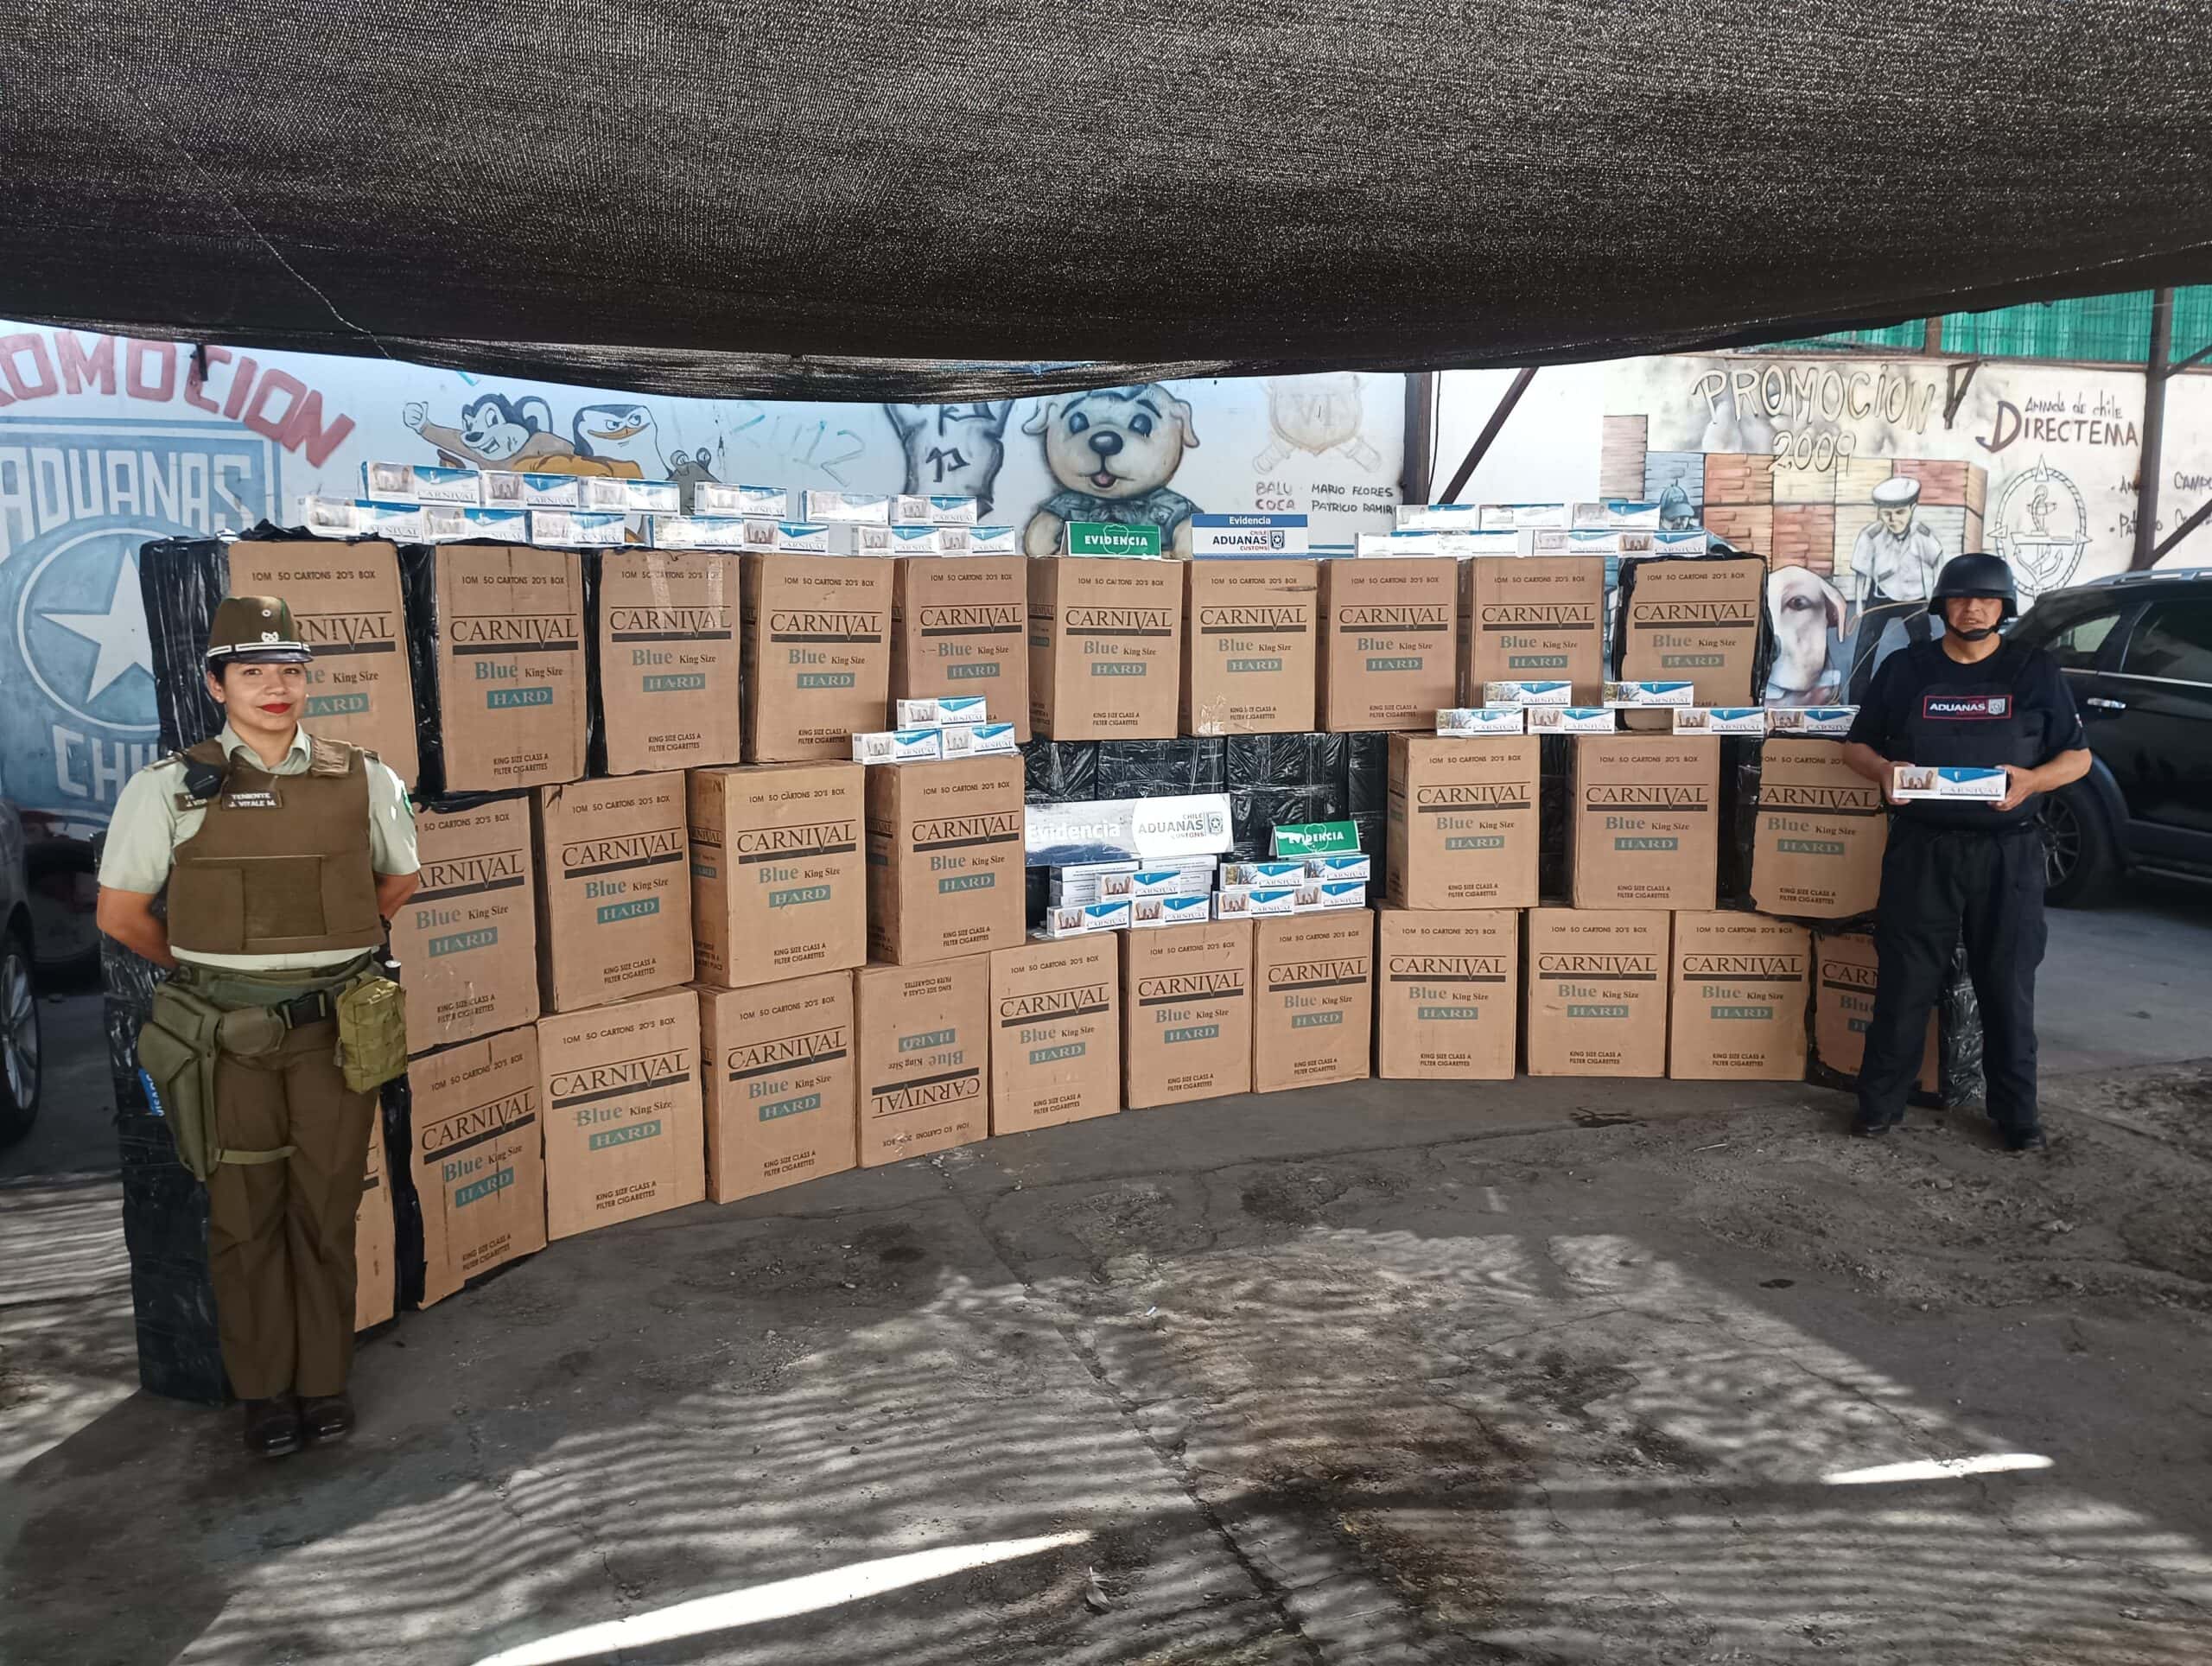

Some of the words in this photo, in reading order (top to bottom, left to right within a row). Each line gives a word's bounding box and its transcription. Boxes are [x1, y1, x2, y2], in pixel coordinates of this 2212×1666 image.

[0, 331, 355, 468] OMOCION
[1975, 401, 2138, 453] DIRECTEMA
[1312, 484, 1345, 495] MARIO
[1353, 486, 1394, 497] FLORES
[0, 447, 254, 557] ADUANAS
[1312, 500, 1357, 512] PATRICIO
[1229, 516, 1271, 525] Evidencia
[1085, 536, 1148, 546] EVIDENCIA
[611, 610, 732, 637] CARNIVAL
[920, 607, 1022, 630] CARNIVAL
[1066, 610, 1172, 634] CARNIVAL
[1200, 608, 1306, 630] CARNIVAL
[1340, 607, 1448, 629] CARNIVAL
[1482, 607, 1595, 627] CARNIVAL
[1634, 604, 1755, 626] CARNIVAL
[296, 617, 394, 650] RNIVAL
[450, 619, 578, 648] CARNIVAL
[771, 614, 882, 640] CARNIVAL
[1653, 634, 1692, 647] Blue
[789, 649, 826, 664] Blue
[334, 673, 357, 683] King
[359, 671, 378, 681] Size
[474, 662, 518, 679] Blue
[525, 668, 544, 677] King
[547, 666, 563, 676] Size
[803, 676, 850, 685] HARD
[494, 690, 548, 705] HARD
[1929, 703, 1986, 711] ADUANAS
[494, 766, 512, 774] FILTER
[513, 763, 548, 773] CIGARETTES
[1417, 785, 1530, 808] CARNIVAL
[1586, 787, 1708, 809] CARNIVAL
[1760, 788, 1876, 813] ARNIVAL
[912, 816, 1019, 842] CARNIVAL
[1139, 821, 1204, 834] ADUANAS
[1437, 817, 1473, 830] Blue
[1768, 817, 1809, 832] Blue
[1815, 826, 1836, 835] King
[563, 832, 683, 866] CARNIVAL
[737, 824, 856, 852] CARNIVAL
[1451, 838, 1499, 848] HARD
[1783, 842, 1839, 852] HARD
[760, 867, 798, 883] Blue
[804, 869, 823, 878] King
[825, 868, 840, 876] Size
[585, 881, 626, 899] Blue
[632, 882, 652, 892] King
[654, 879, 669, 887] Size
[776, 888, 826, 905] HARD
[604, 901, 655, 920] HARD
[1268, 960, 1367, 982] CARNIVAL
[1389, 958, 1506, 980] CARNIVAL
[1539, 956, 1656, 977] CARNIVAL
[1683, 957, 1802, 979] CARNIVAL
[1139, 973, 1243, 996] CARNIVAL
[1559, 984, 1597, 997] Blue
[1001, 987, 1109, 1018] CARNIVAL
[728, 1031, 846, 1069] CARNIVAL
[550, 1053, 690, 1097] CARNIVAL
[871, 1078, 980, 1113] CARNIVAL
[422, 1093, 535, 1149] CARNIVAL
[576, 1106, 622, 1126] Blue
[629, 1105, 652, 1116] King
[653, 1101, 672, 1111] Size
[597, 1123, 656, 1147] HARD
[596, 1192, 613, 1201] KING
[615, 1188, 627, 1197] SIZE
[628, 1182, 650, 1193] CLASS
[596, 1199, 615, 1210] FILTER
[618, 1190, 655, 1205] CIGARETTES
